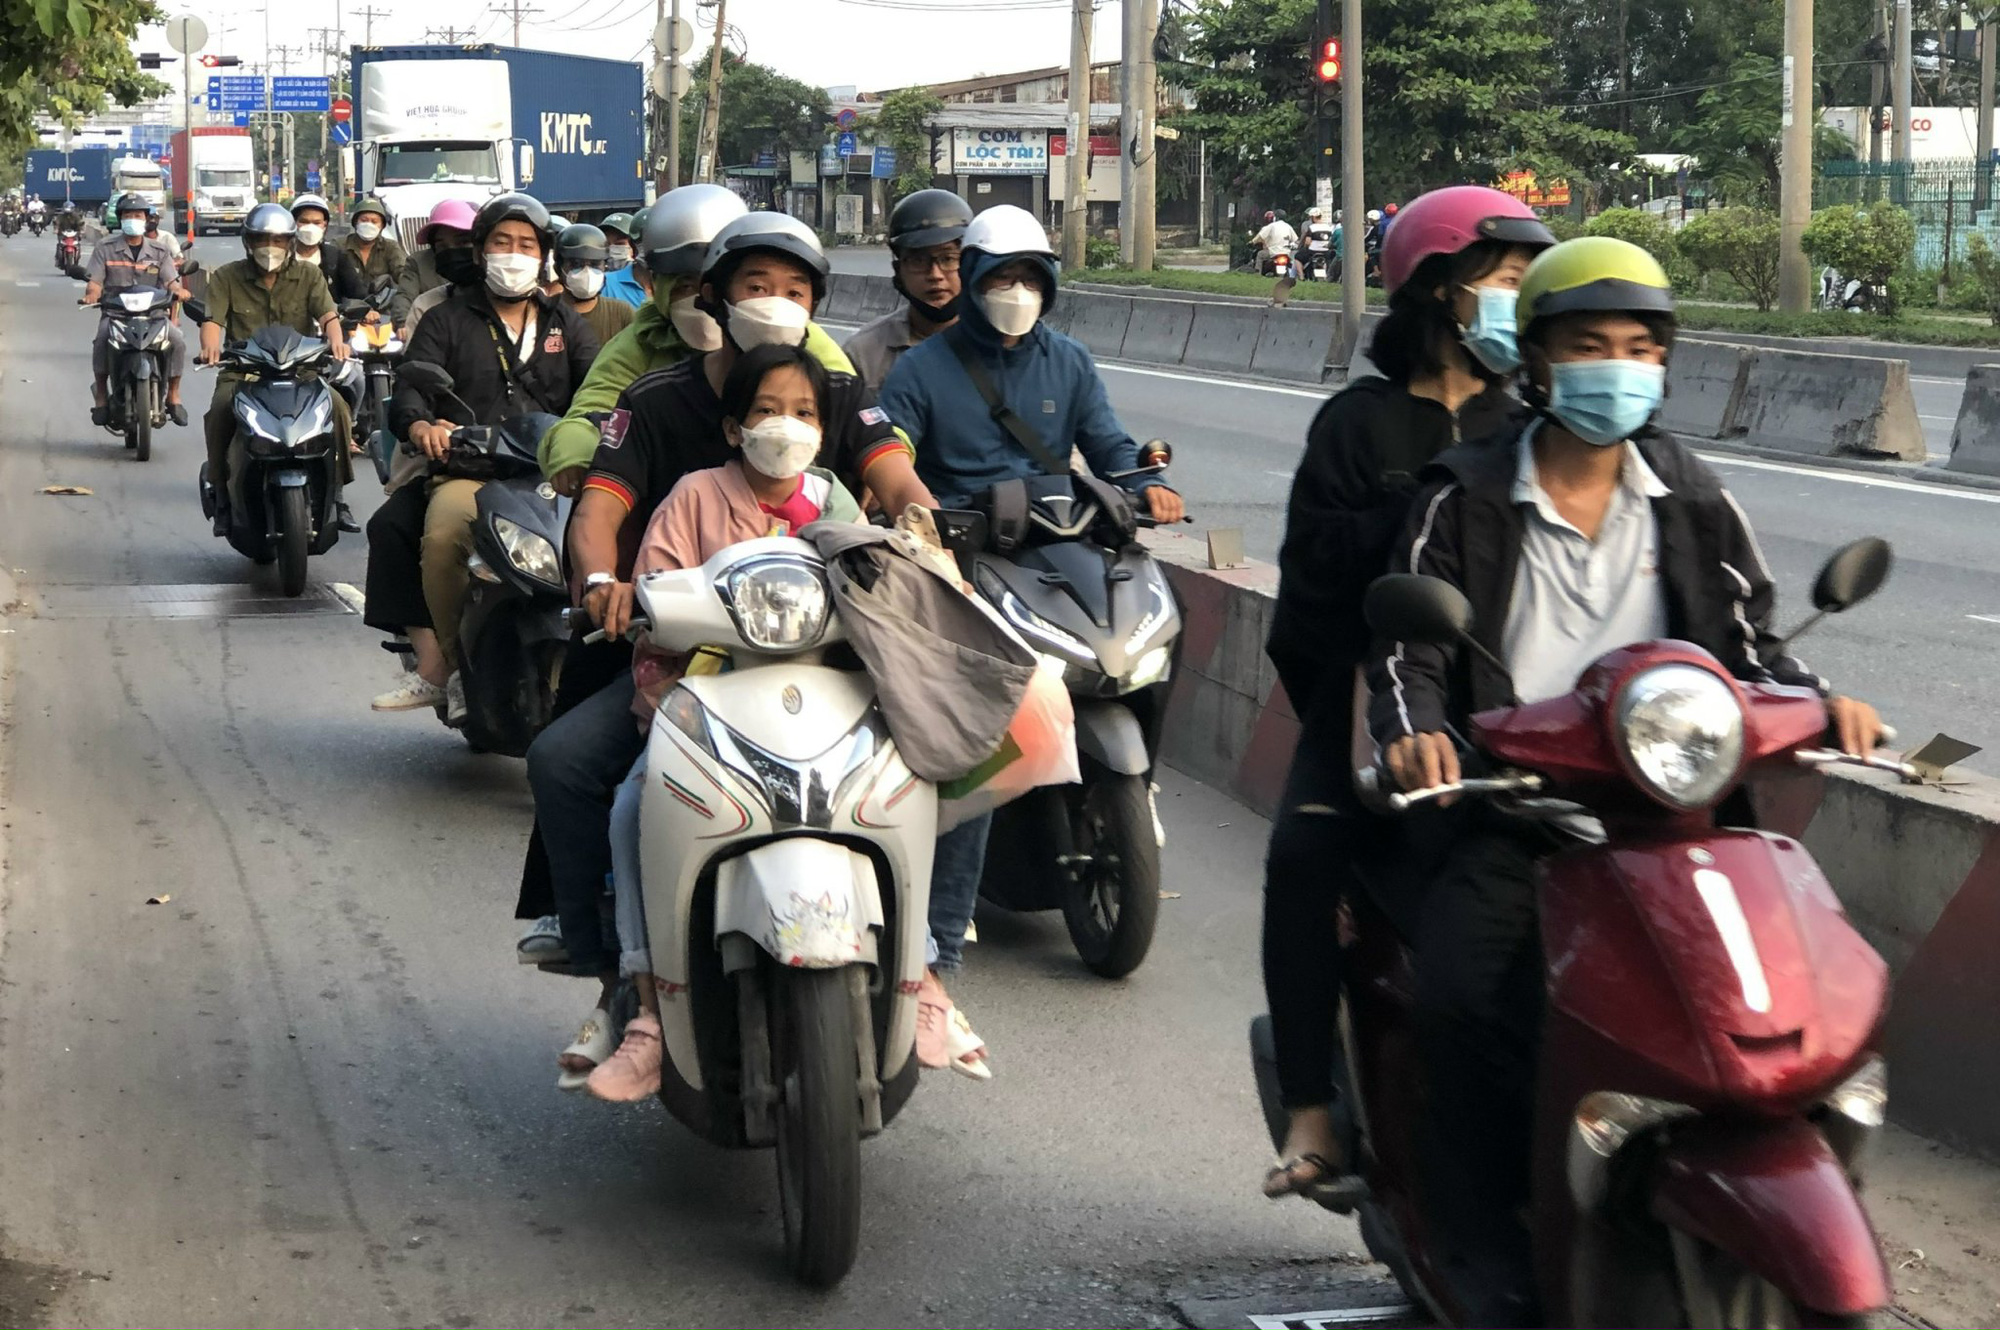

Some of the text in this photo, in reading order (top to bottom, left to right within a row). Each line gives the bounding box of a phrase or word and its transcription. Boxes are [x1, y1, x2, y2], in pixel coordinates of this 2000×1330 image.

[541, 112, 592, 155] KMTC
[978, 128, 1022, 142] CƠM
[966, 144, 1001, 160] LỘC
[1037, 147, 1044, 158] 2
